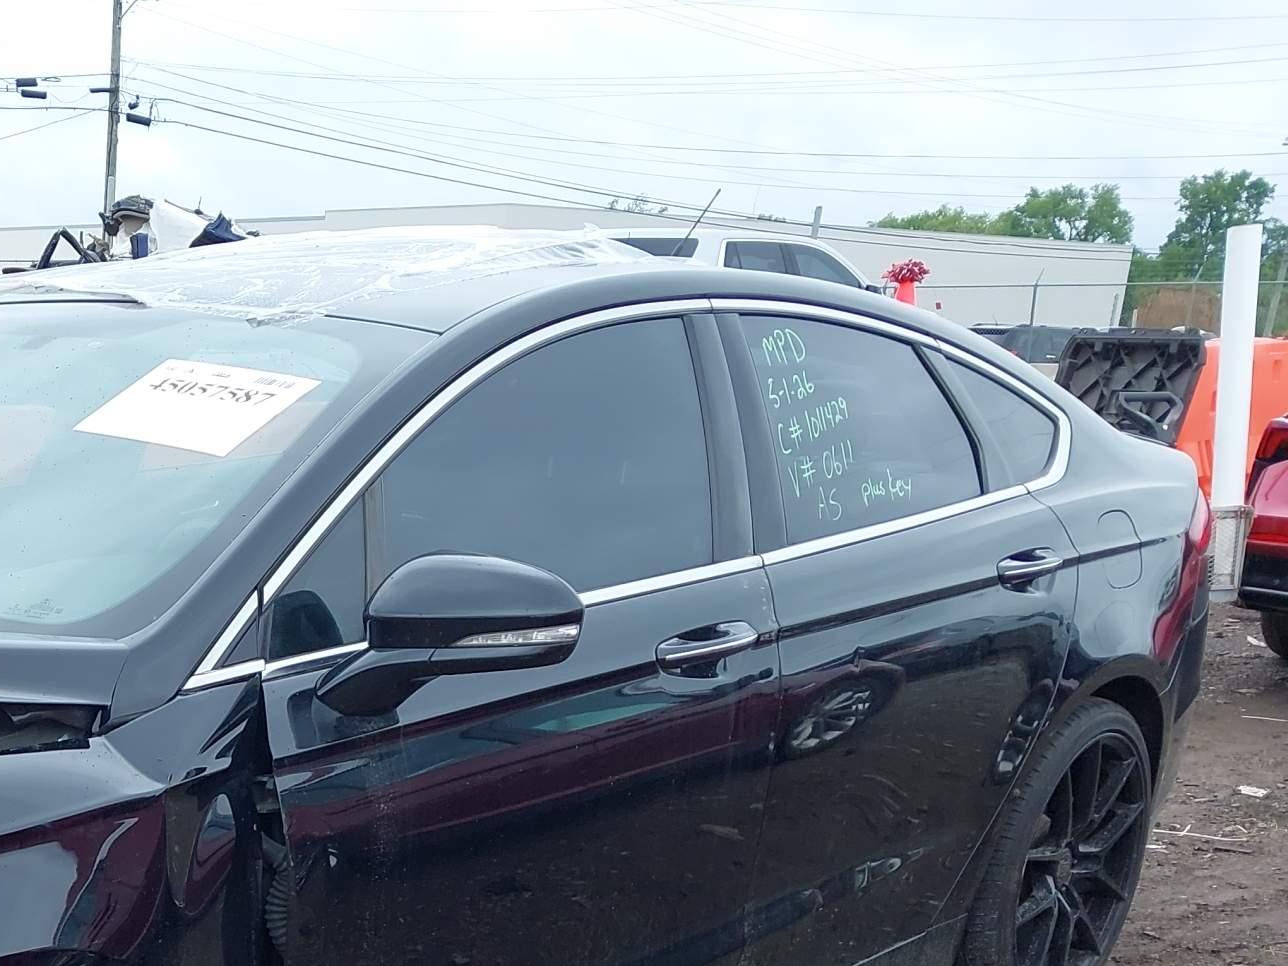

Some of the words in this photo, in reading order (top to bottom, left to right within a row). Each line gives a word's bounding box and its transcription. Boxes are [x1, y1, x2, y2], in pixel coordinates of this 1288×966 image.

[761, 328, 806, 367] MPD
[149, 378, 278, 405] 45057587
[816, 486, 842, 522] AS
